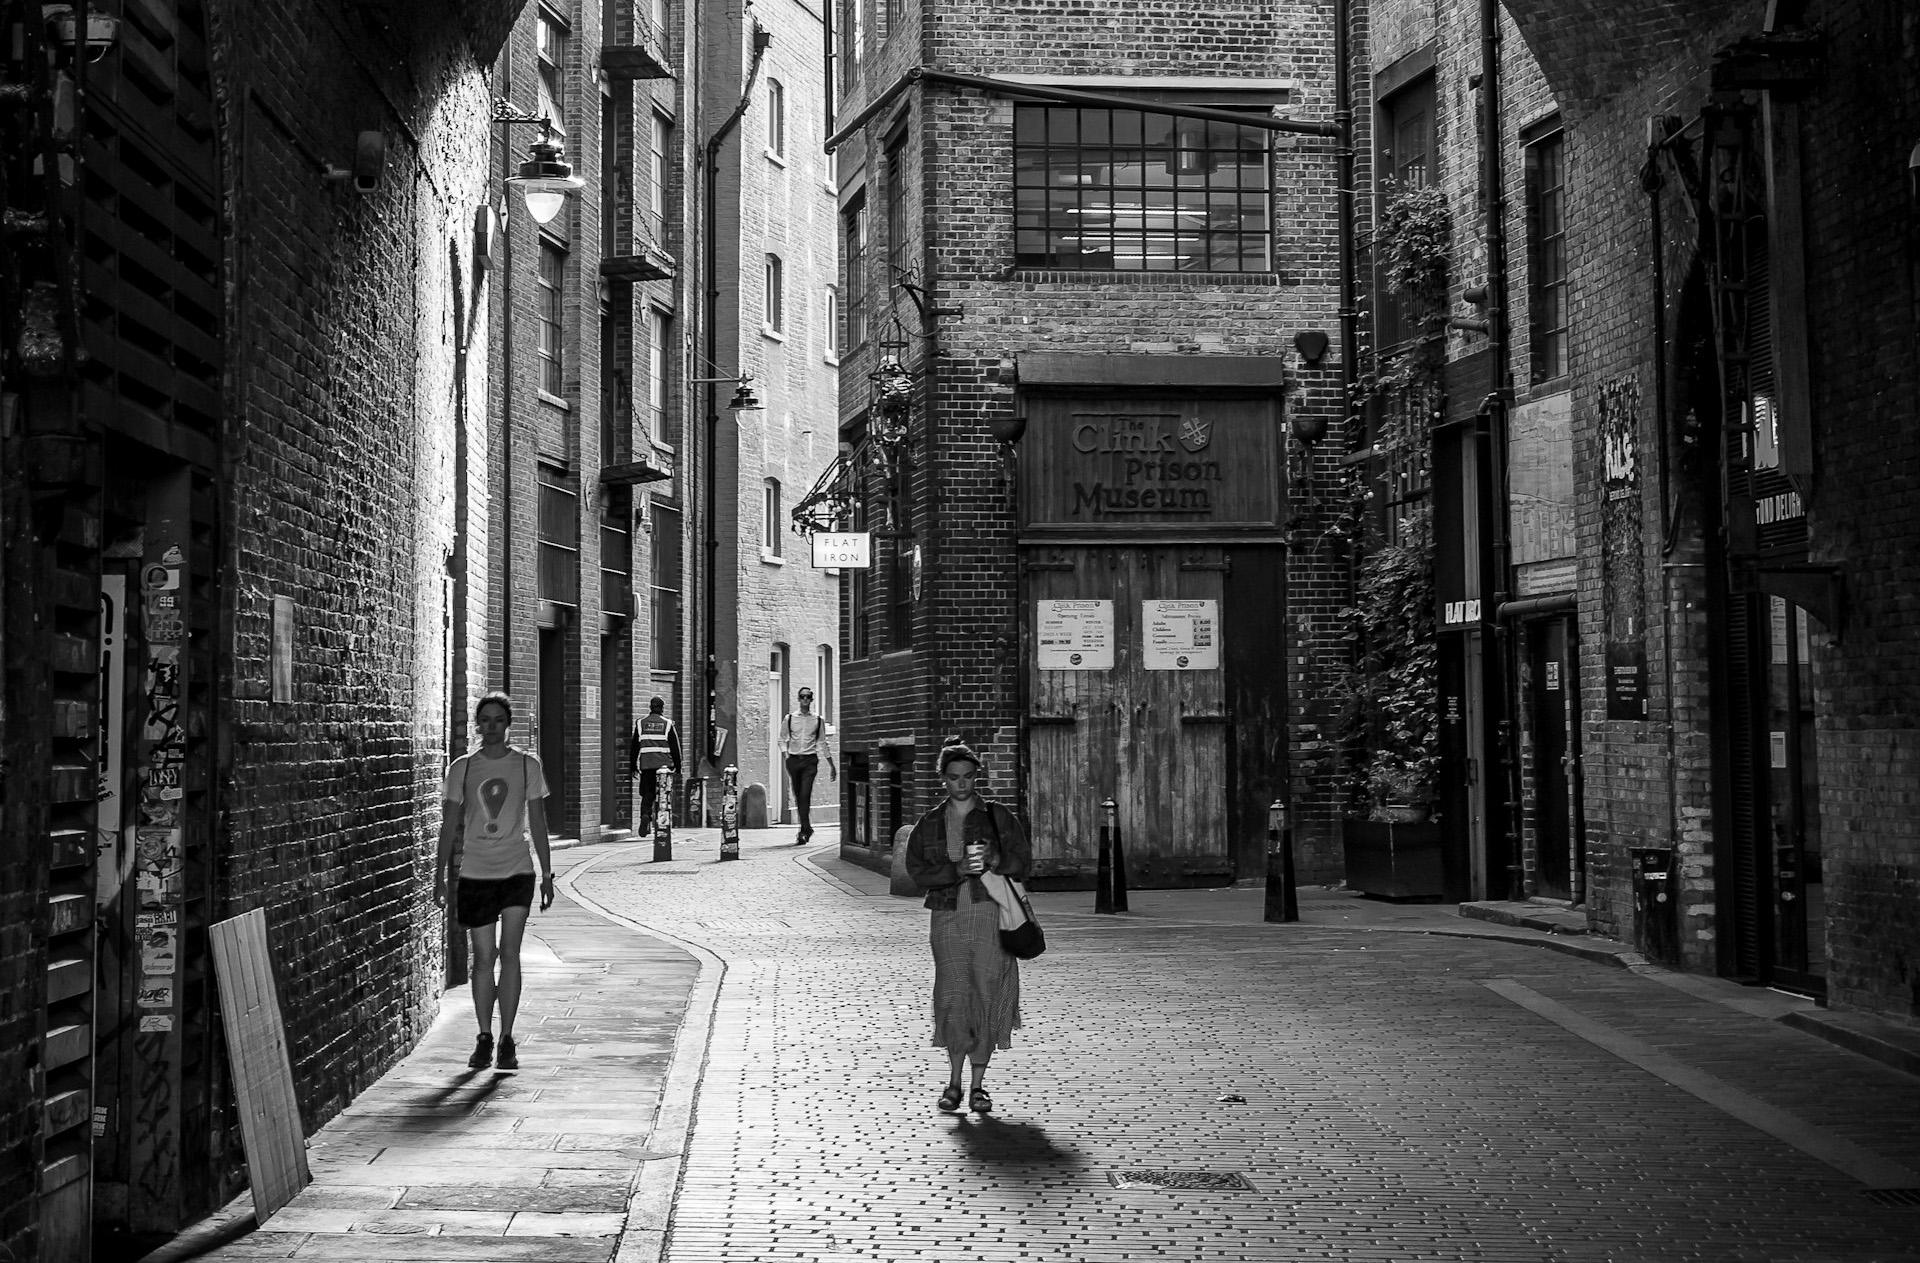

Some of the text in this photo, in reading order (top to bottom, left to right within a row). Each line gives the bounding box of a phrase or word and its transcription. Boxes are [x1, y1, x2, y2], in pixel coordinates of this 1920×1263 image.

[1117, 417, 1145, 431] The
[1072, 423, 1177, 454] Clink
[1124, 456, 1223, 486] Prison
[1072, 482, 1212, 515] Museum
[824, 538, 858, 547] FLAT
[824, 553, 859, 562] IRON
